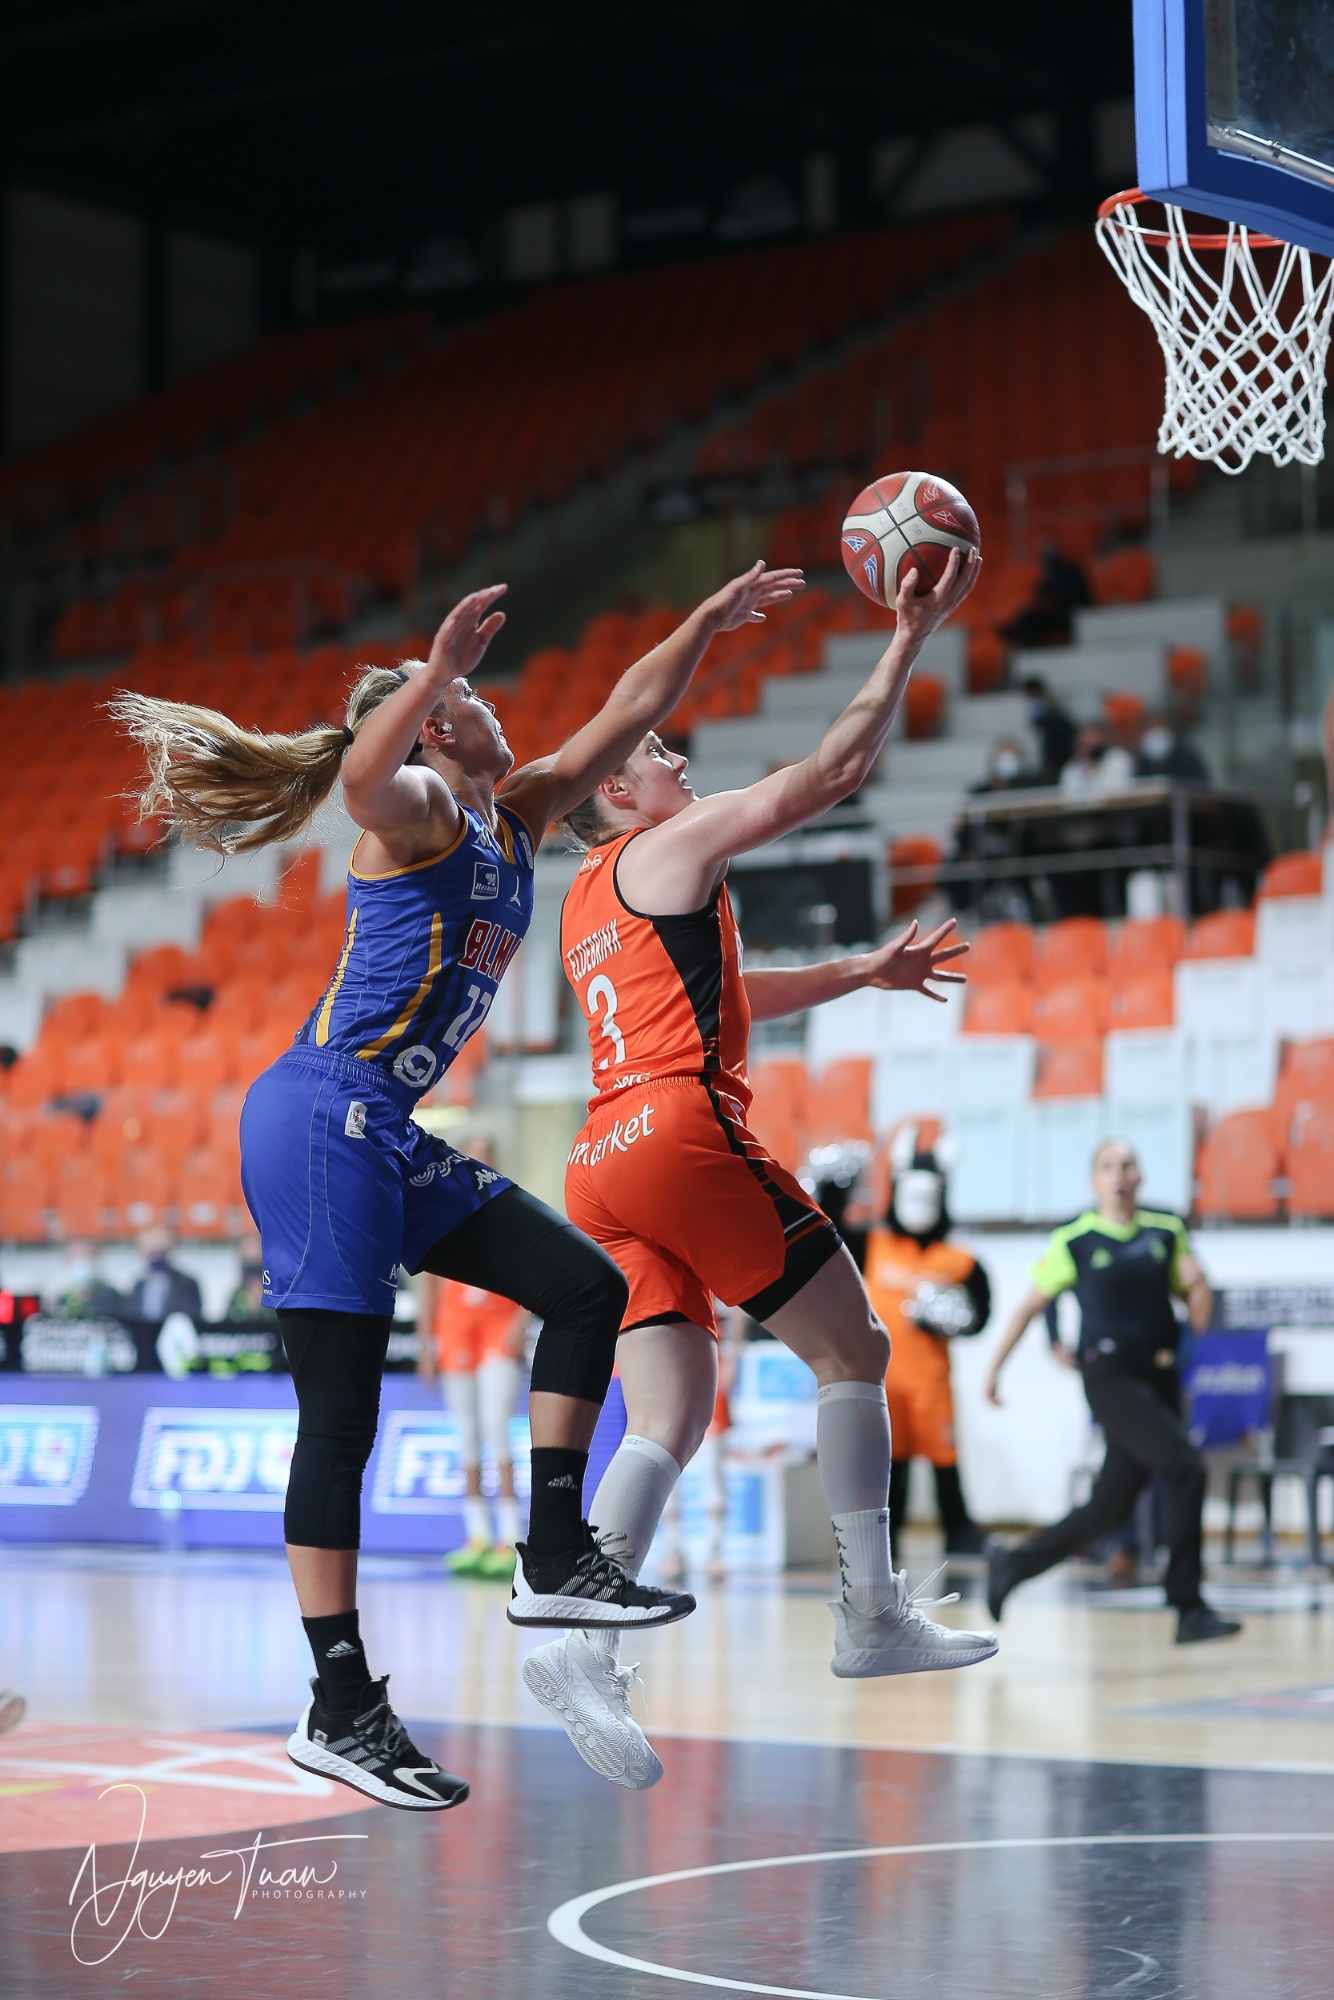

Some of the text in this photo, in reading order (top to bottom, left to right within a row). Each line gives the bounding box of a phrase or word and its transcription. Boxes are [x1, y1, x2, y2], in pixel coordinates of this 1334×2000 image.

[567, 918, 622, 983] ELDEBRINK
[442, 984, 492, 1053] 22
[587, 974, 627, 1070] 3
[569, 1103, 655, 1167] market
